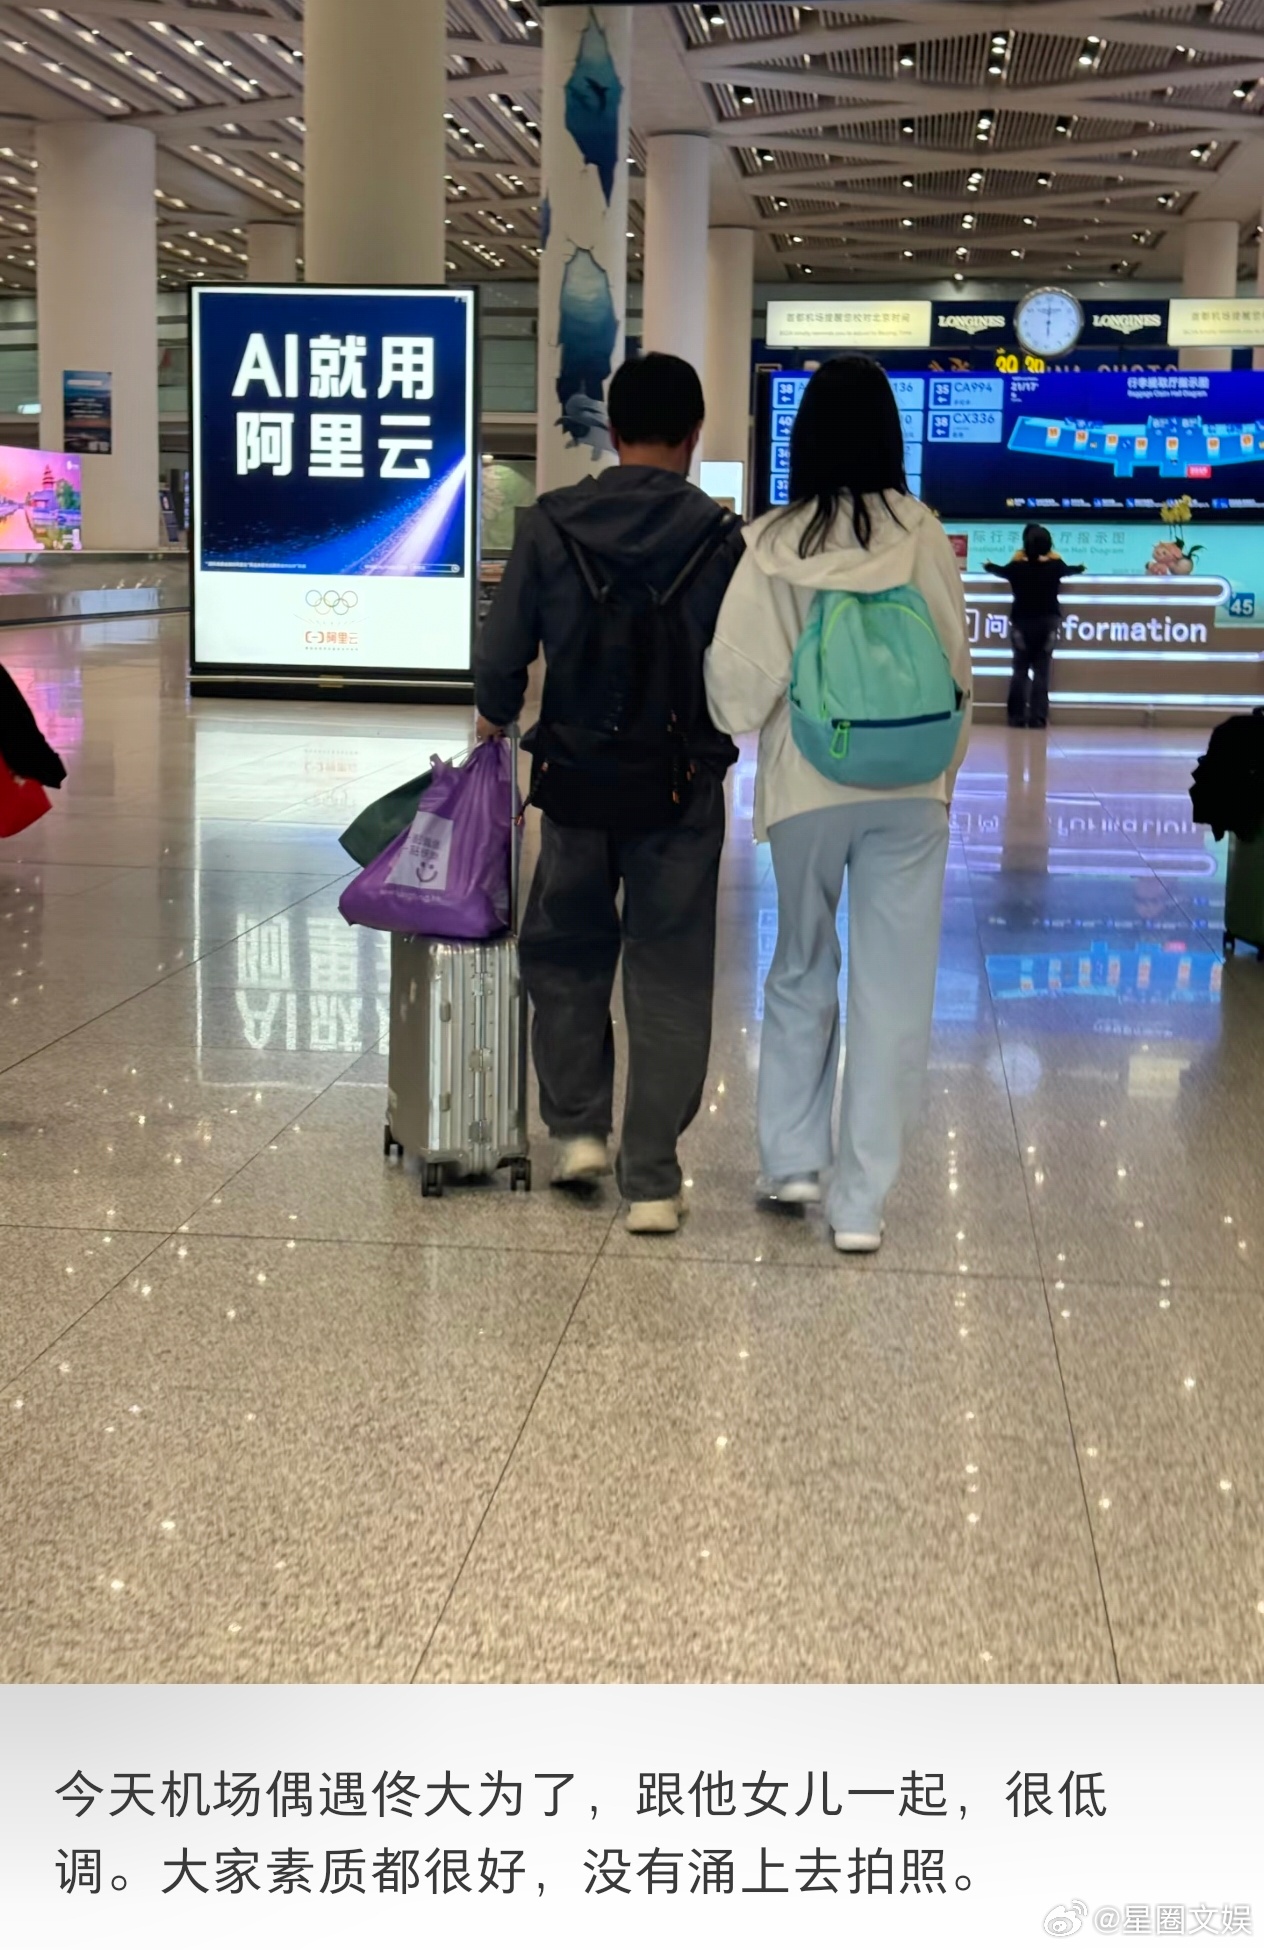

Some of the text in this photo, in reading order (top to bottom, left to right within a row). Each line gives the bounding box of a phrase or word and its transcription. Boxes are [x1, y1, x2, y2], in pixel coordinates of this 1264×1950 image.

[938, 315, 1006, 328] LONGINES
[1092, 314, 1162, 328] LONGINES
[231, 333, 435, 400] AI就用
[779, 383, 793, 394] 38
[935, 384, 950, 395] 35
[954, 382, 993, 393] CA994
[934, 417, 949, 428] 38
[953, 413, 995, 424] CX336
[235, 412, 433, 479] 阿里云
[1231, 598, 1253, 615] 45
[1057, 614, 1208, 643] formation
[326, 632, 358, 645] 阿里云
